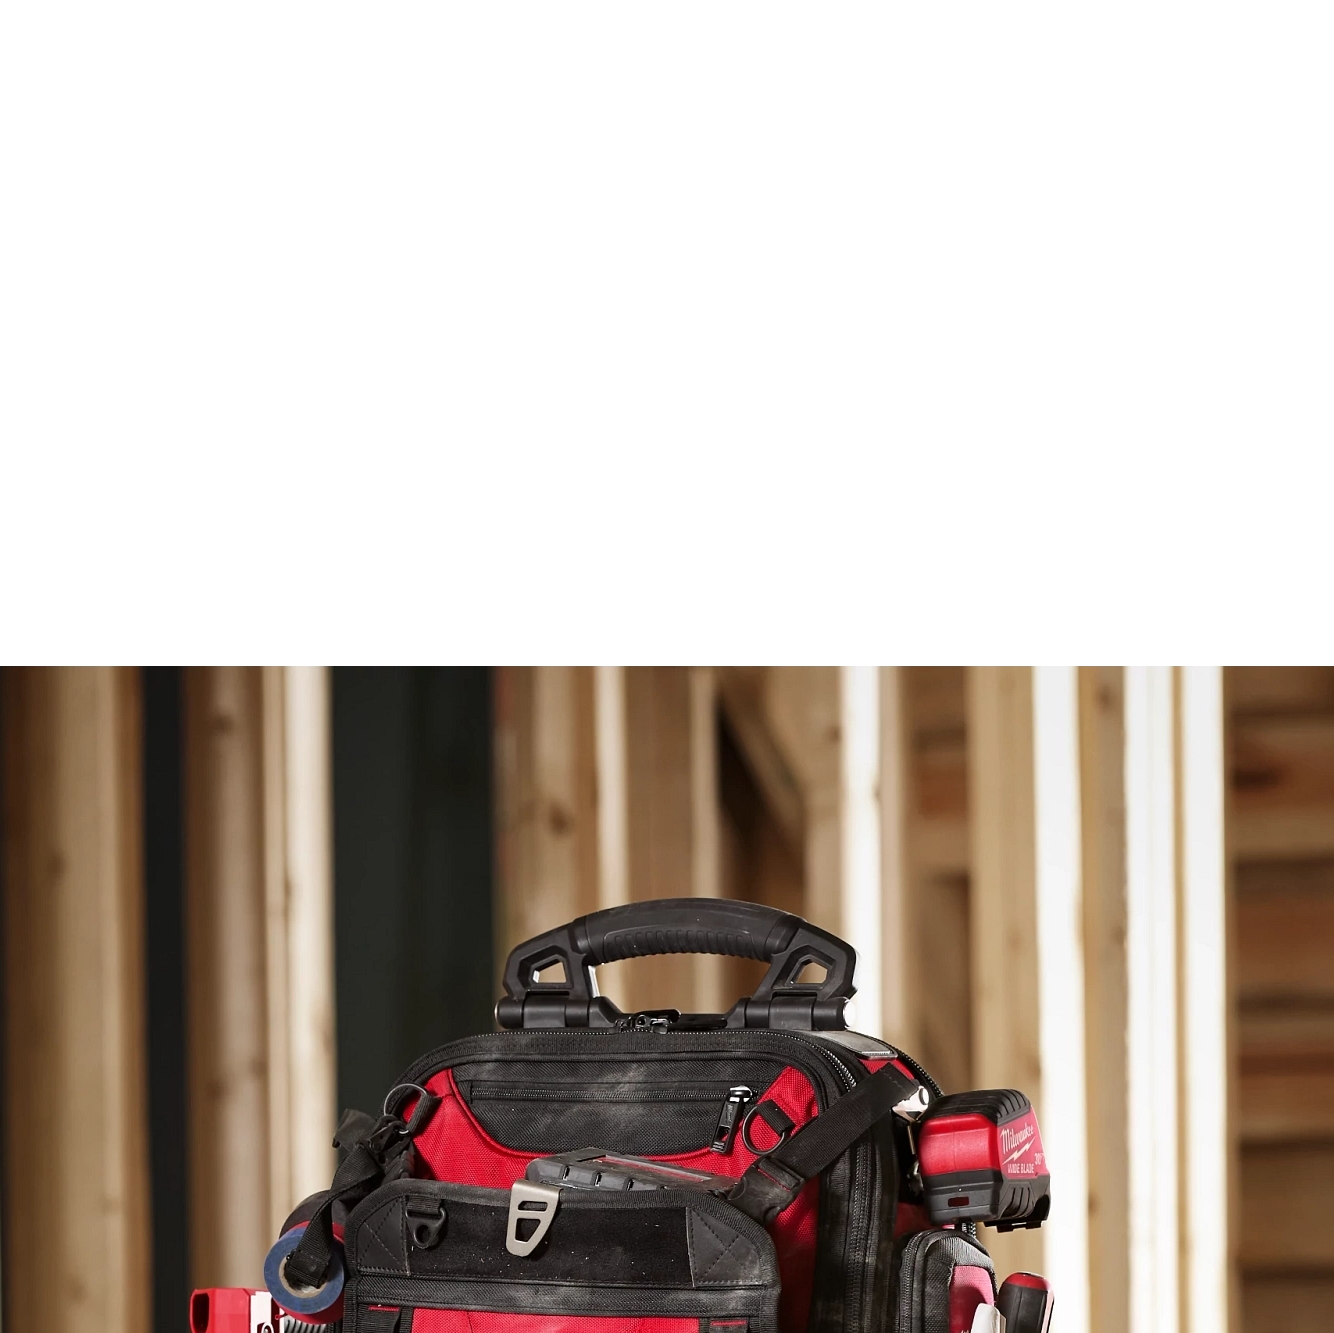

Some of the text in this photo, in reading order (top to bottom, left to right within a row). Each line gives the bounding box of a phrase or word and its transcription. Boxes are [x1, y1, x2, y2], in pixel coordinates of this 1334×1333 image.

[1000, 1122, 1034, 1155] Milwaukee
[1007, 1163, 1035, 1174] WIDE BLADE
